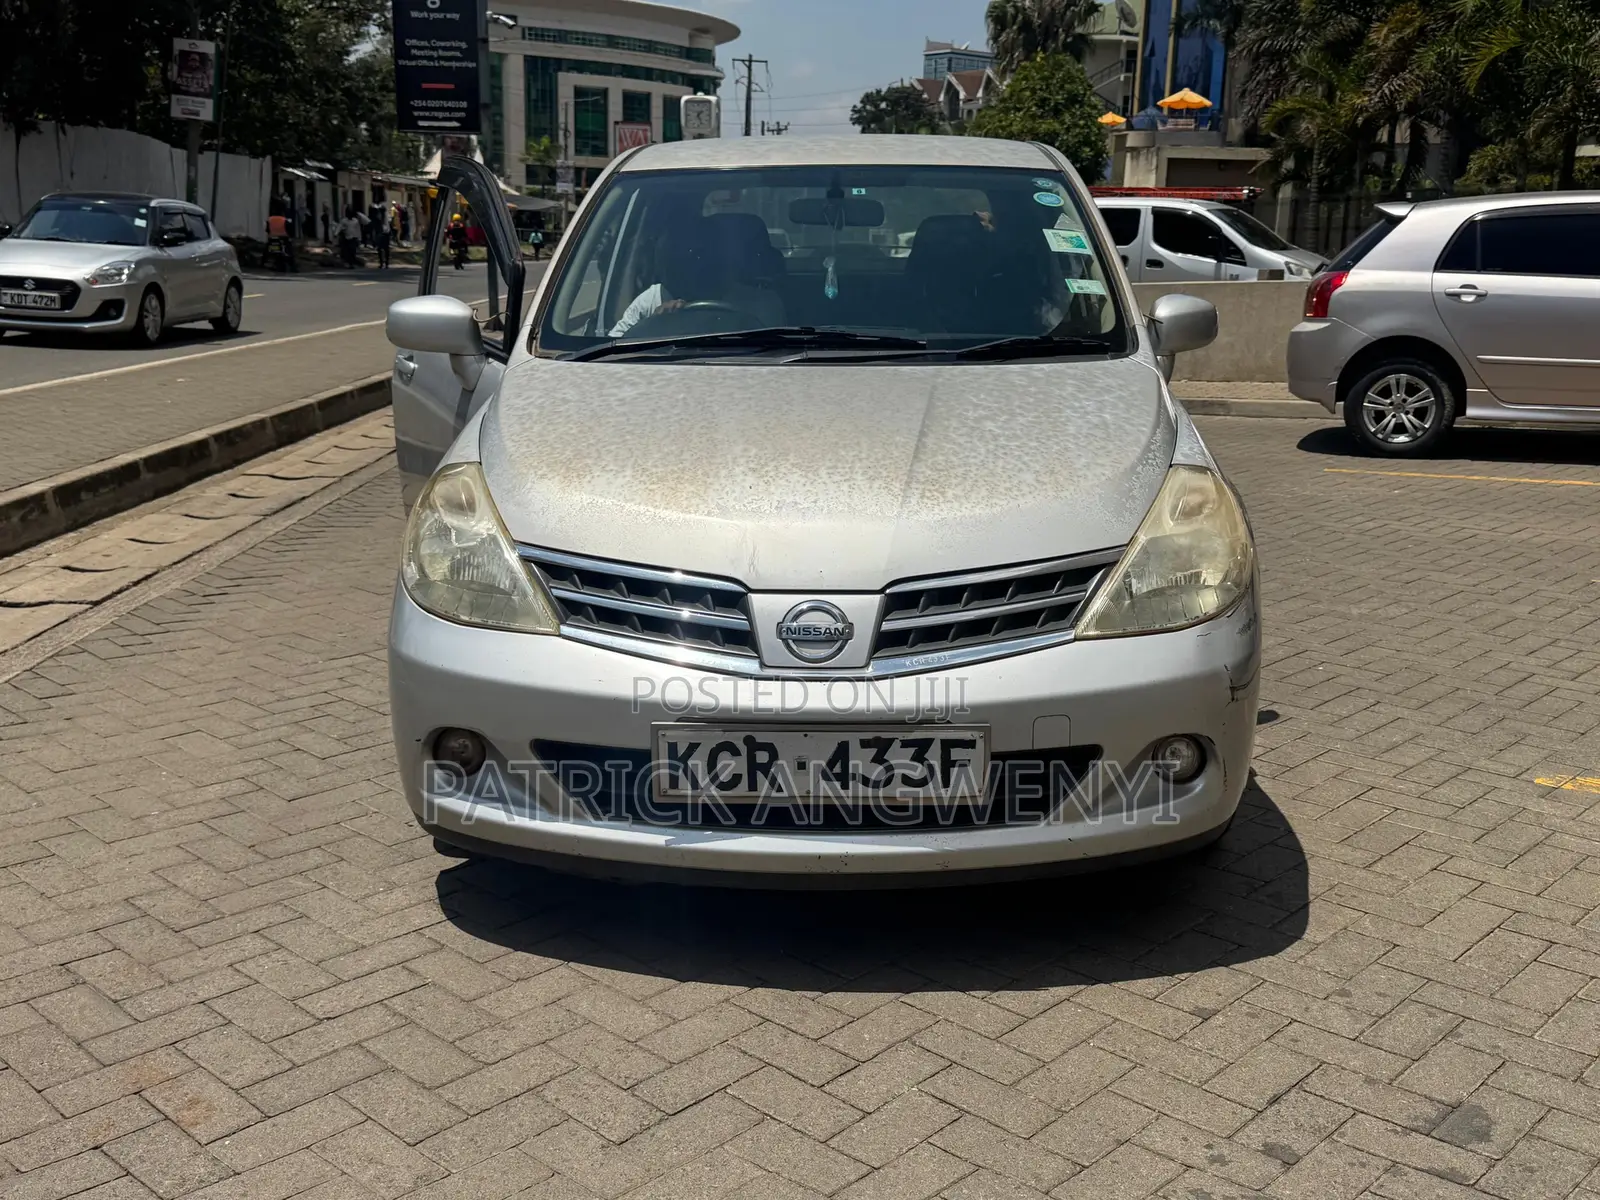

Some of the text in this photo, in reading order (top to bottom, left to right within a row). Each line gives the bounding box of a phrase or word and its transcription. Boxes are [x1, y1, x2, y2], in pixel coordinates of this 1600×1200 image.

[410, 10, 428, 18] Work
[429, 12, 445, 20] your
[411, 49, 438, 58] Meeting
[10, 293, 28, 305] KDT
[785, 626, 845, 637] NISSAN
[666, 735, 977, 792] KCR 433F
